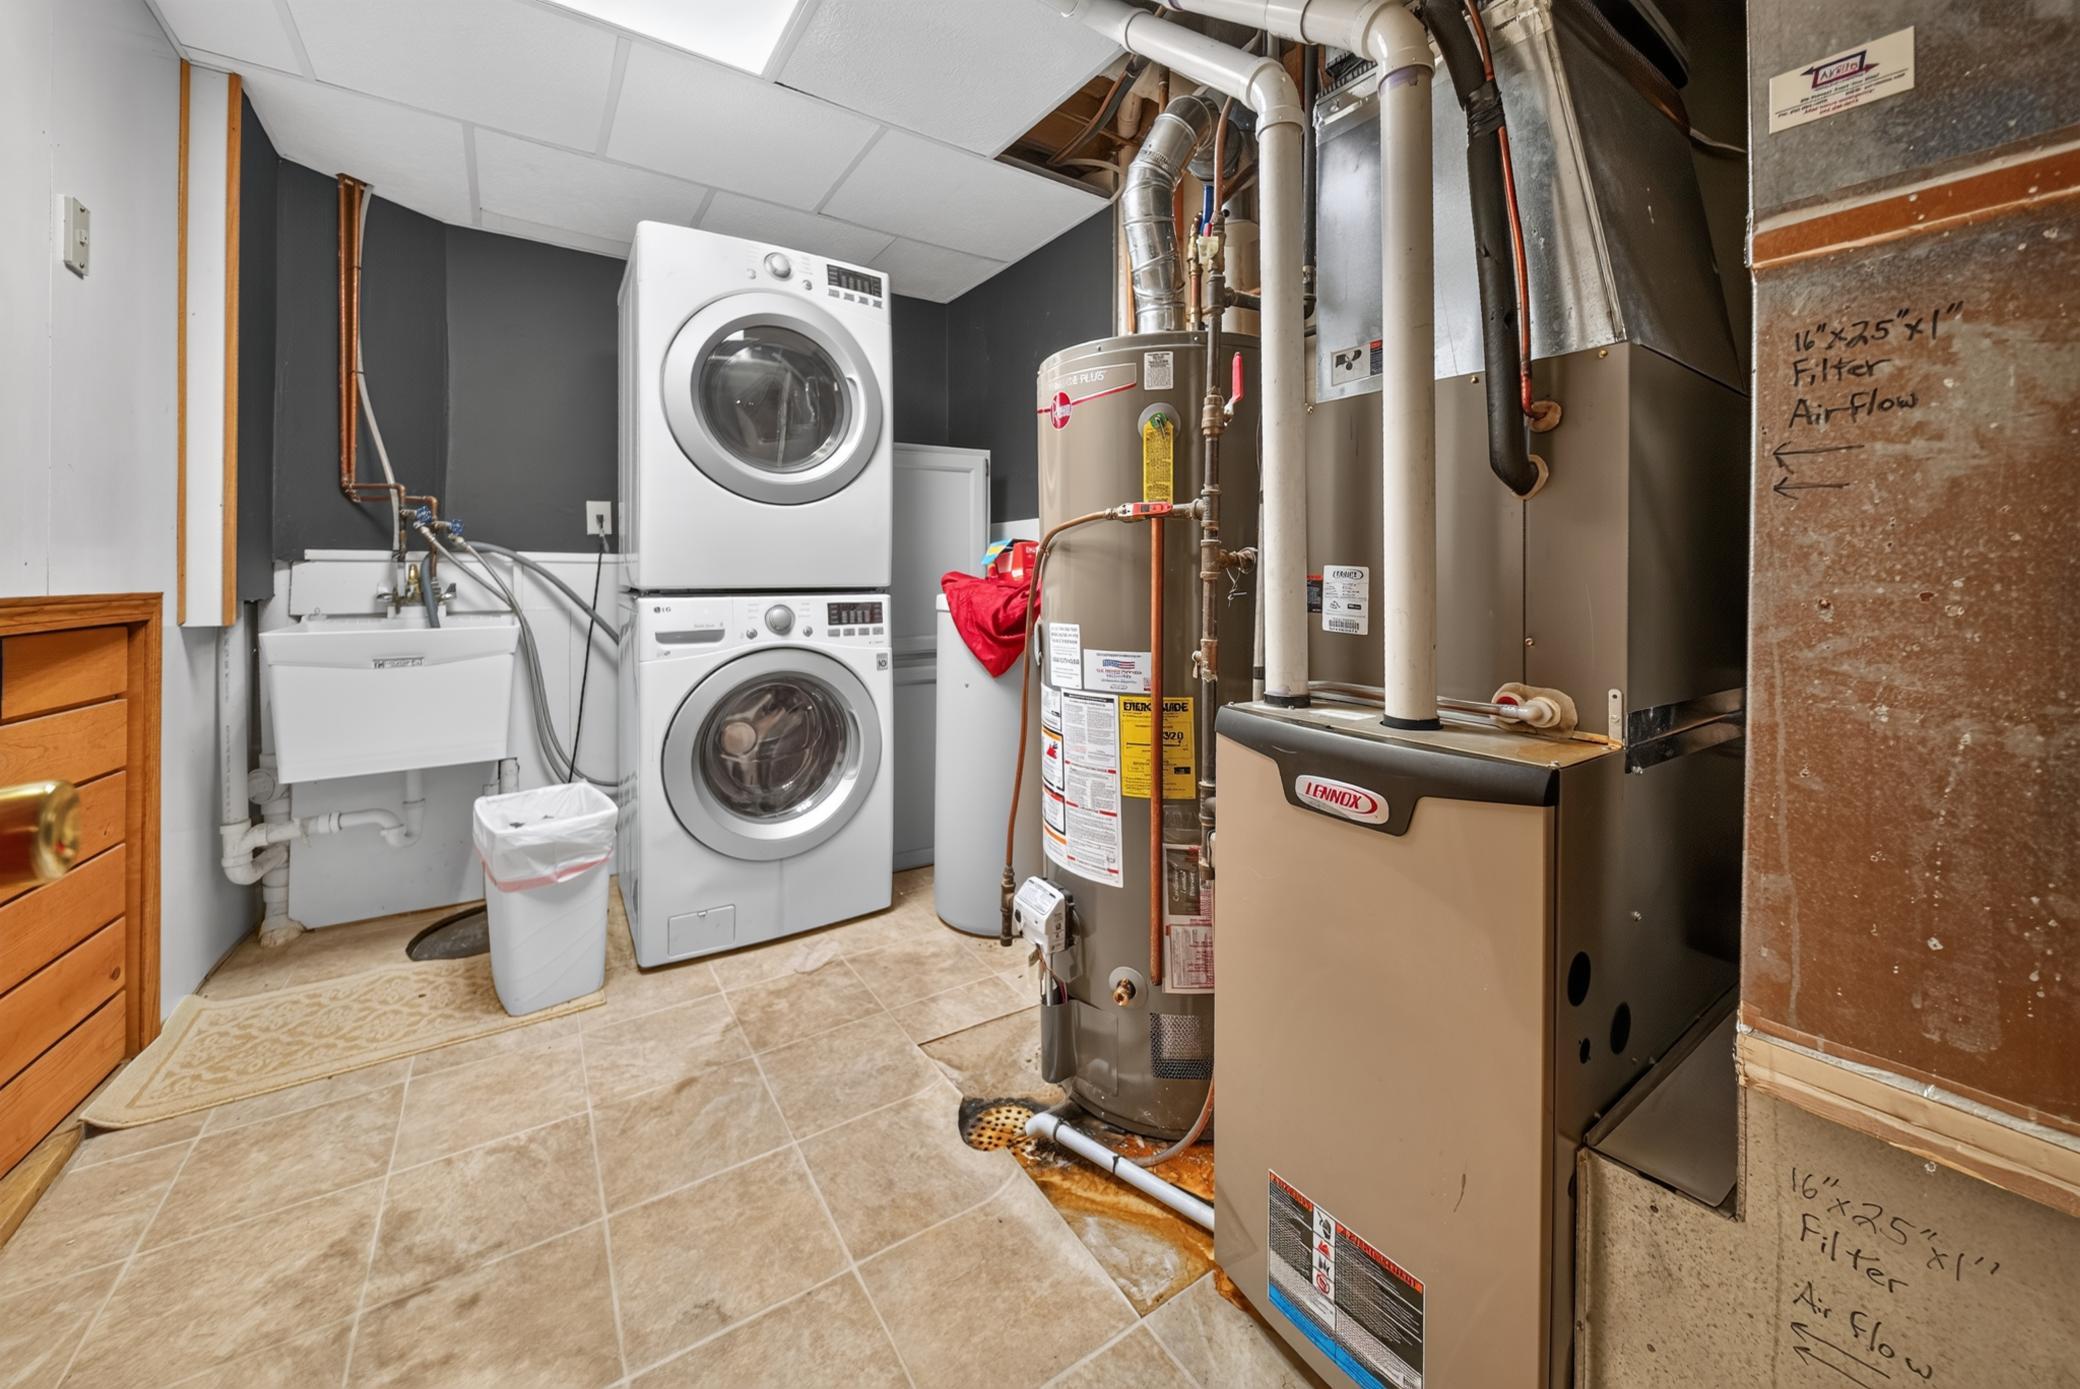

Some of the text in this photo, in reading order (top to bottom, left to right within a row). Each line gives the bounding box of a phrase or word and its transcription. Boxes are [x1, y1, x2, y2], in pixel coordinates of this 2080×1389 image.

[1793, 357, 1893, 387] Filter
[1305, 782, 1362, 809] LENNOX
[1800, 1213, 1909, 1293] Filter
[1850, 1310, 1933, 1380] Flow
